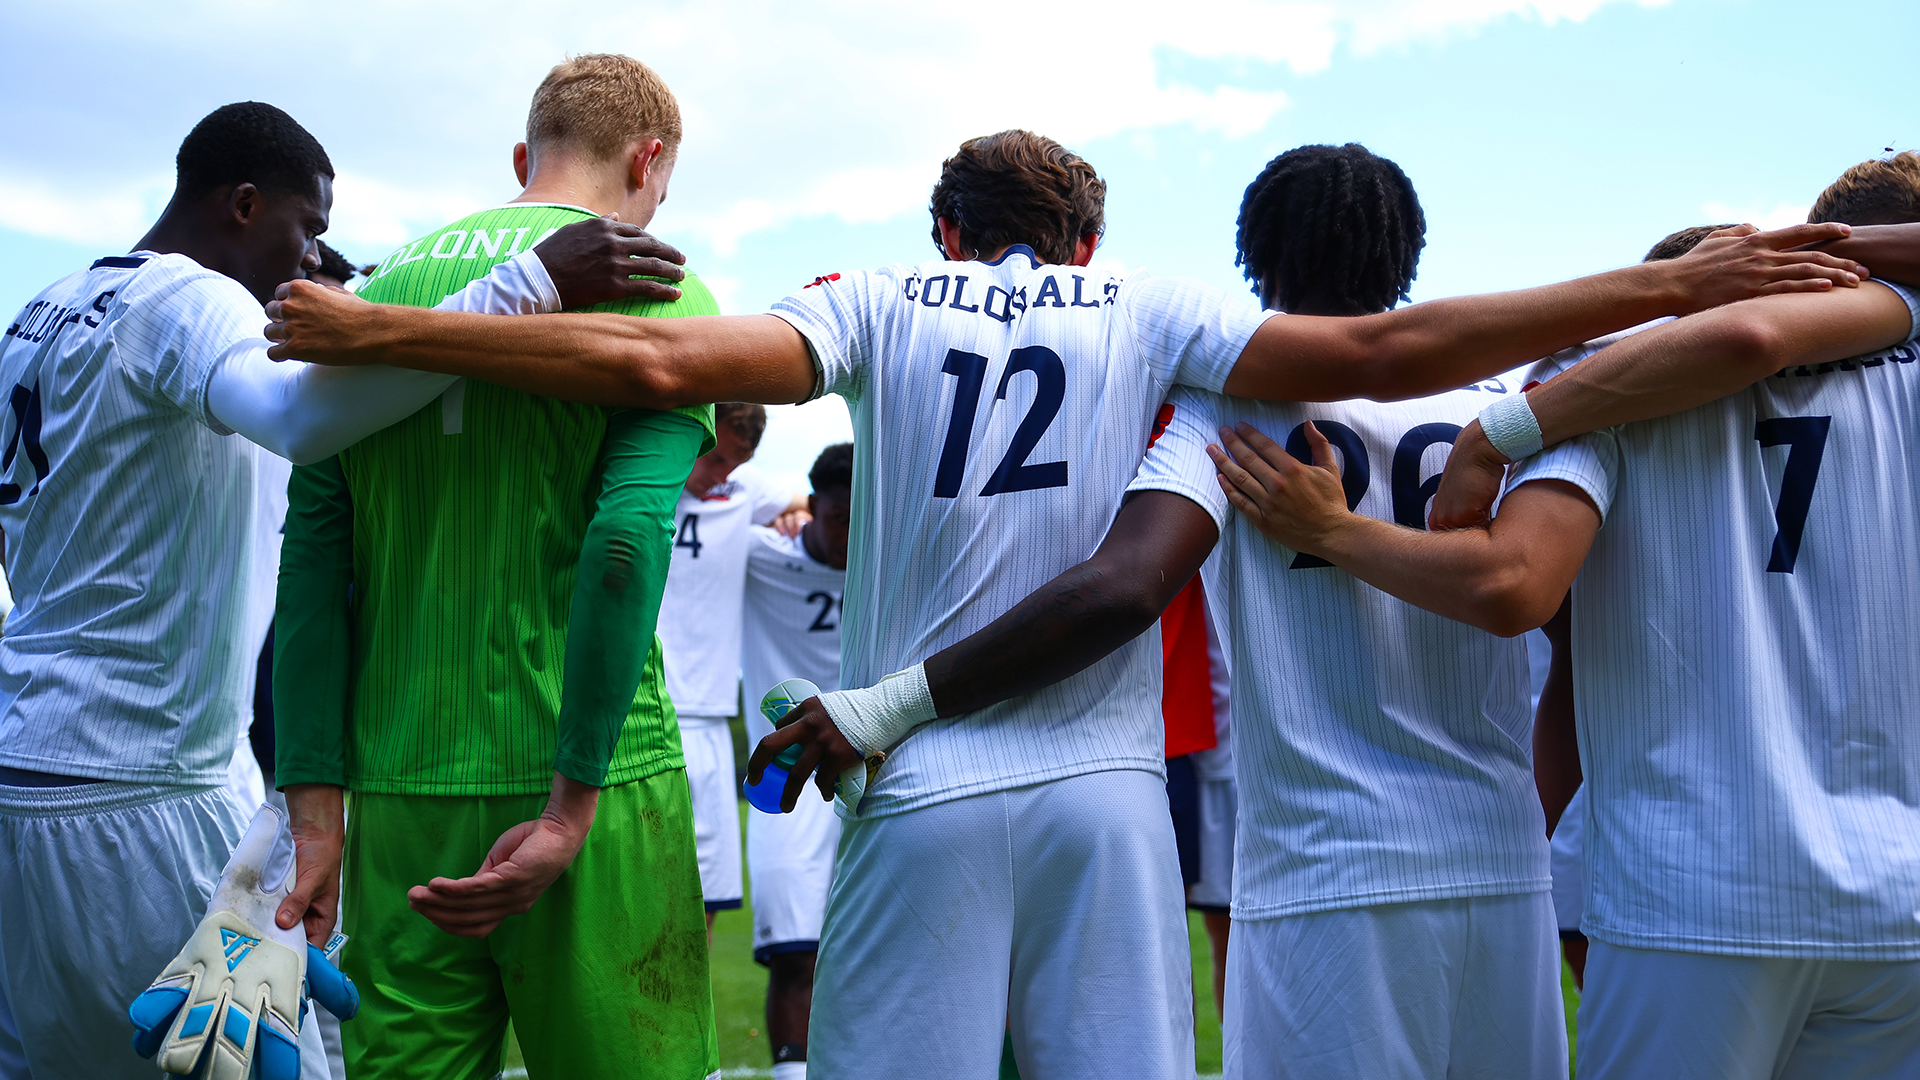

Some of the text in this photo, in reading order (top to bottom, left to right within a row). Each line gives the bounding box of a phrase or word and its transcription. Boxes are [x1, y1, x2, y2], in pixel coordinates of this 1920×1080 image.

[933, 345, 1068, 498] 12
[675, 513, 703, 559] 4
[1754, 415, 1832, 574] 7
[806, 591, 844, 633] 2
